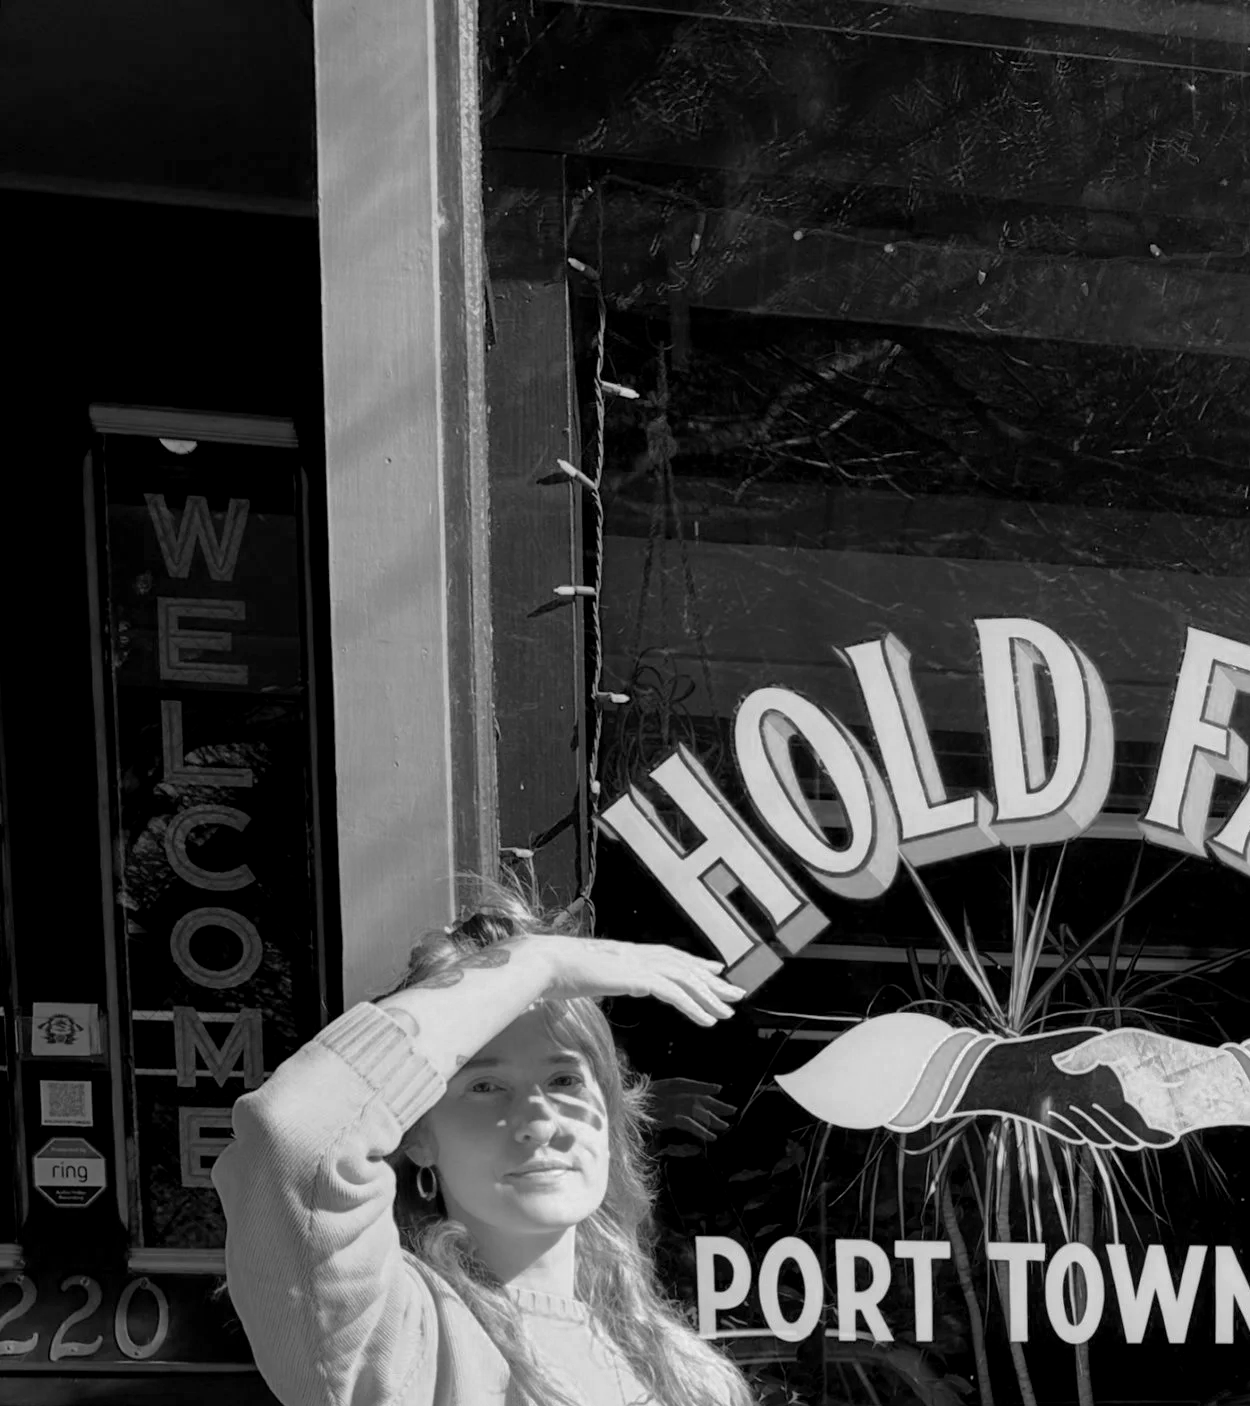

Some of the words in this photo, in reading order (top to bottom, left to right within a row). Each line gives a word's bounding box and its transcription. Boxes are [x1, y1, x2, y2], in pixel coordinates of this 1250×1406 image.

[143, 492, 264, 1188] WELCOME
[593, 617, 1114, 998] HOLD
[52, 1162, 89, 1183] ring
[0, 1274, 169, 1361] 220
[694, 1235, 951, 1344] PORT
